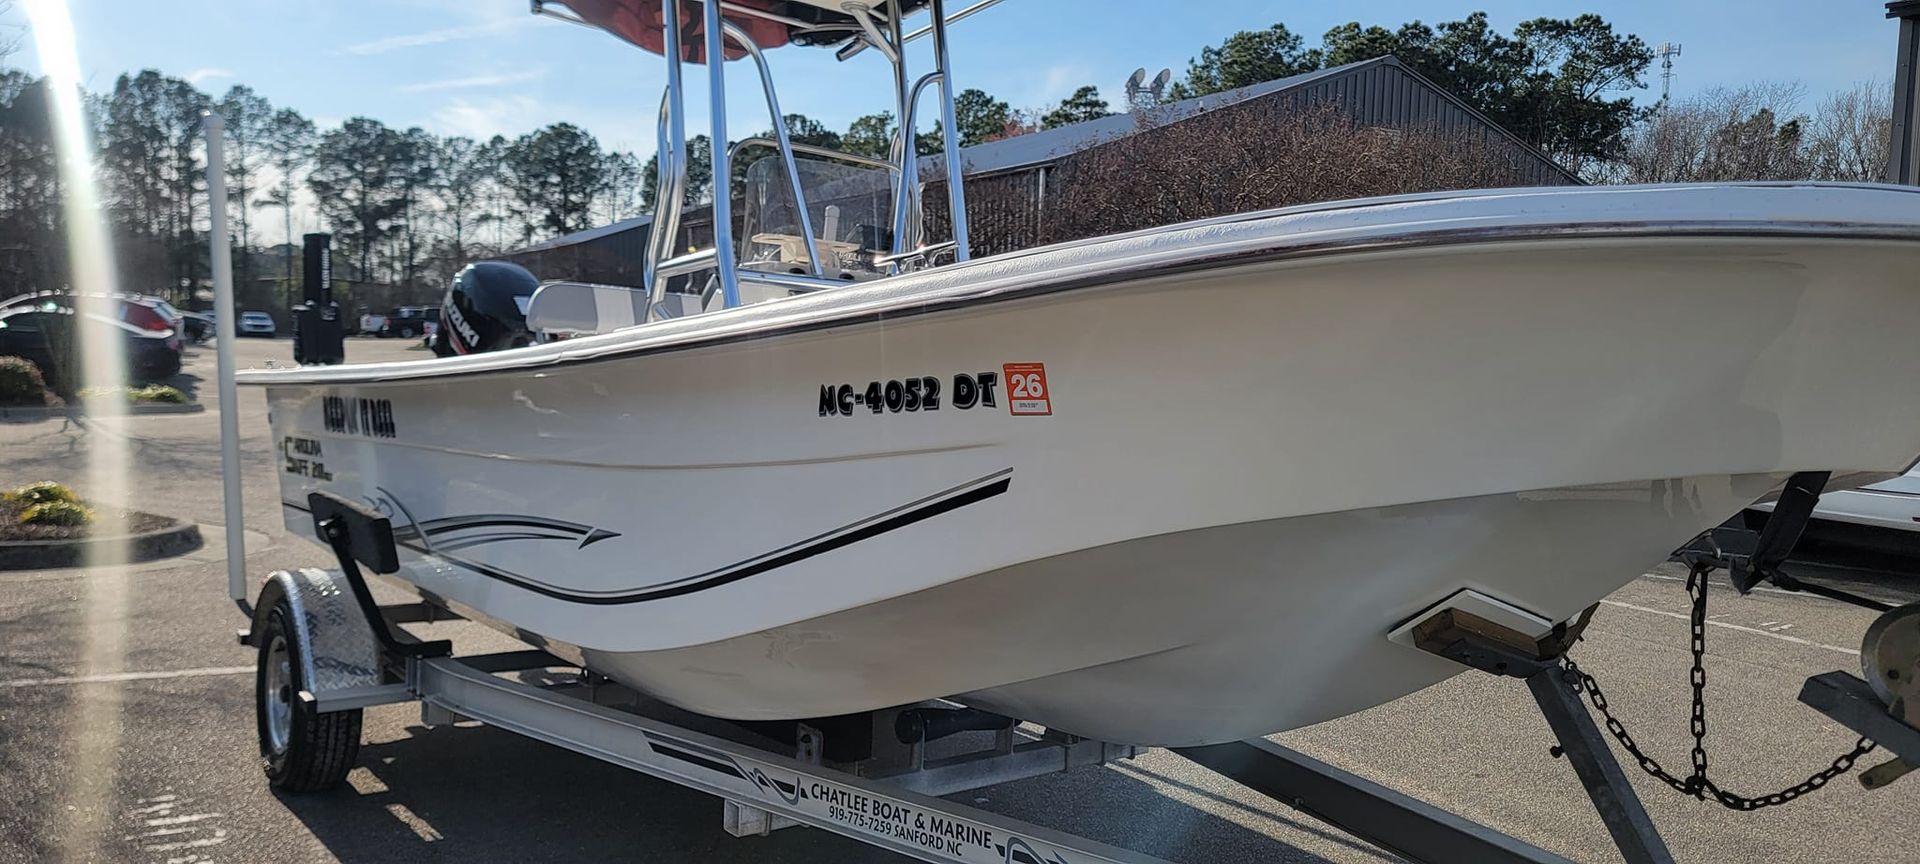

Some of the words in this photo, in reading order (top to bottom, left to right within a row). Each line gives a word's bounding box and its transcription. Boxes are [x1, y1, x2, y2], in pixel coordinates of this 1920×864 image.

[819, 377, 941, 417] NC-4052
[952, 372, 998, 410] DT
[1011, 374, 1043, 398] 26
[811, 783, 868, 813] CHATLEE
[873, 799, 911, 825] BOAT
[914, 812, 925, 830] &
[930, 816, 992, 849] MARINE
[829, 805, 891, 835] 919-775-7259
[894, 824, 944, 850] SANFORD
[947, 839, 962, 857] NC
